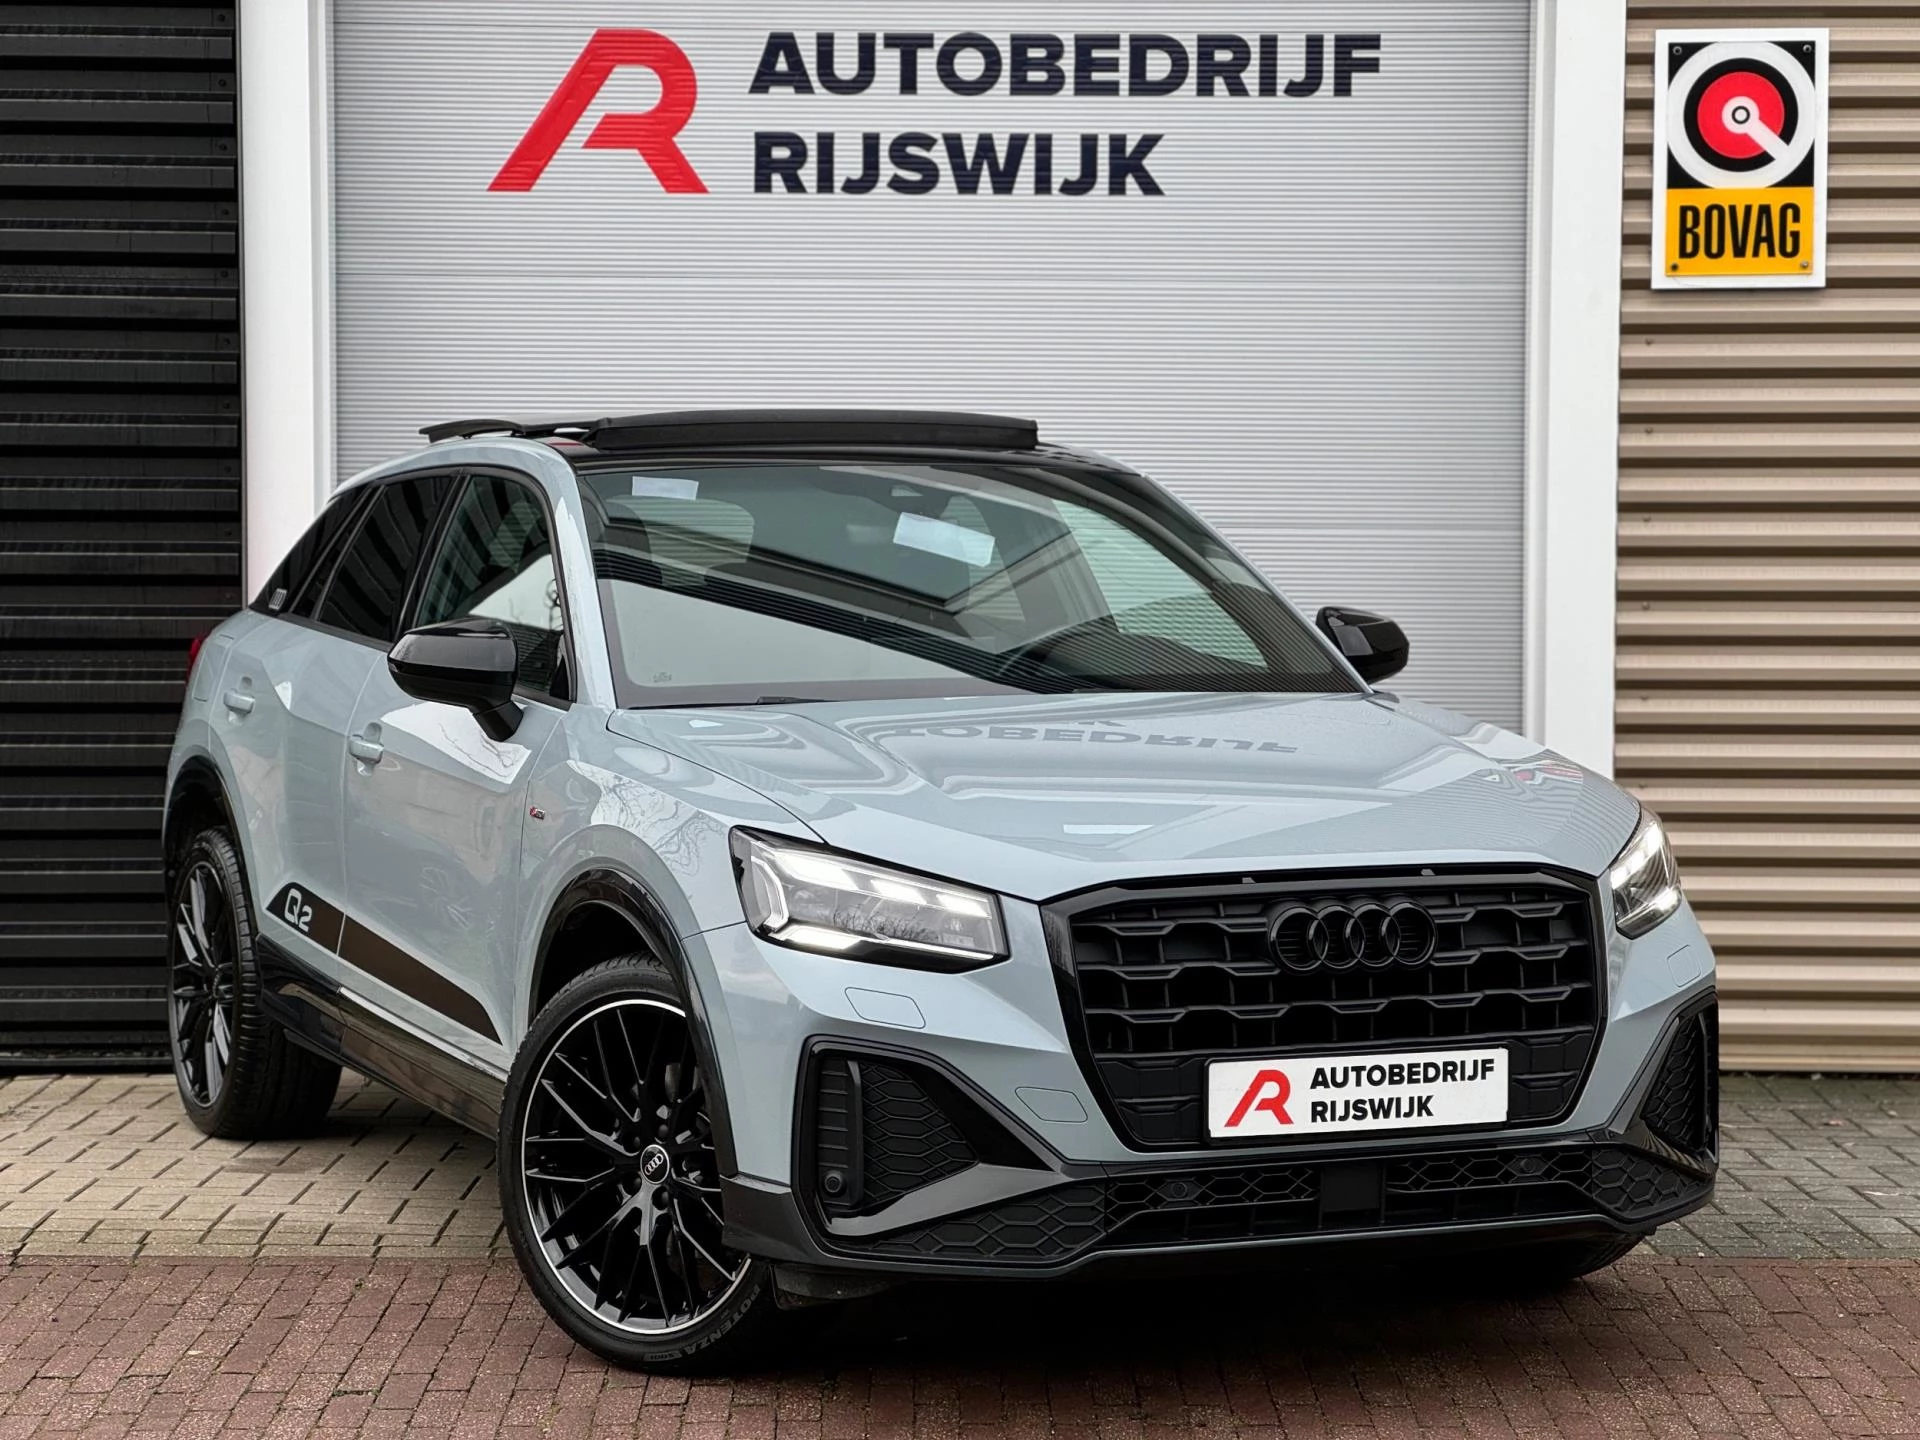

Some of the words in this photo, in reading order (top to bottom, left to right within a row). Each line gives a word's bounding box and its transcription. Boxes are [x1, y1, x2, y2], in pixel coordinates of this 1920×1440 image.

[749, 33, 1381, 97] AUTOBEDRIJF
[755, 132, 1164, 195] RIJSWIJK
[1679, 203, 1800, 259] BOVAG
[284, 888, 313, 932] Q2
[1310, 1059, 1494, 1089] AUTOBEDRIJF
[1312, 1096, 1433, 1122] RIJSWIJK
[684, 1284, 761, 1355] POTENZA
